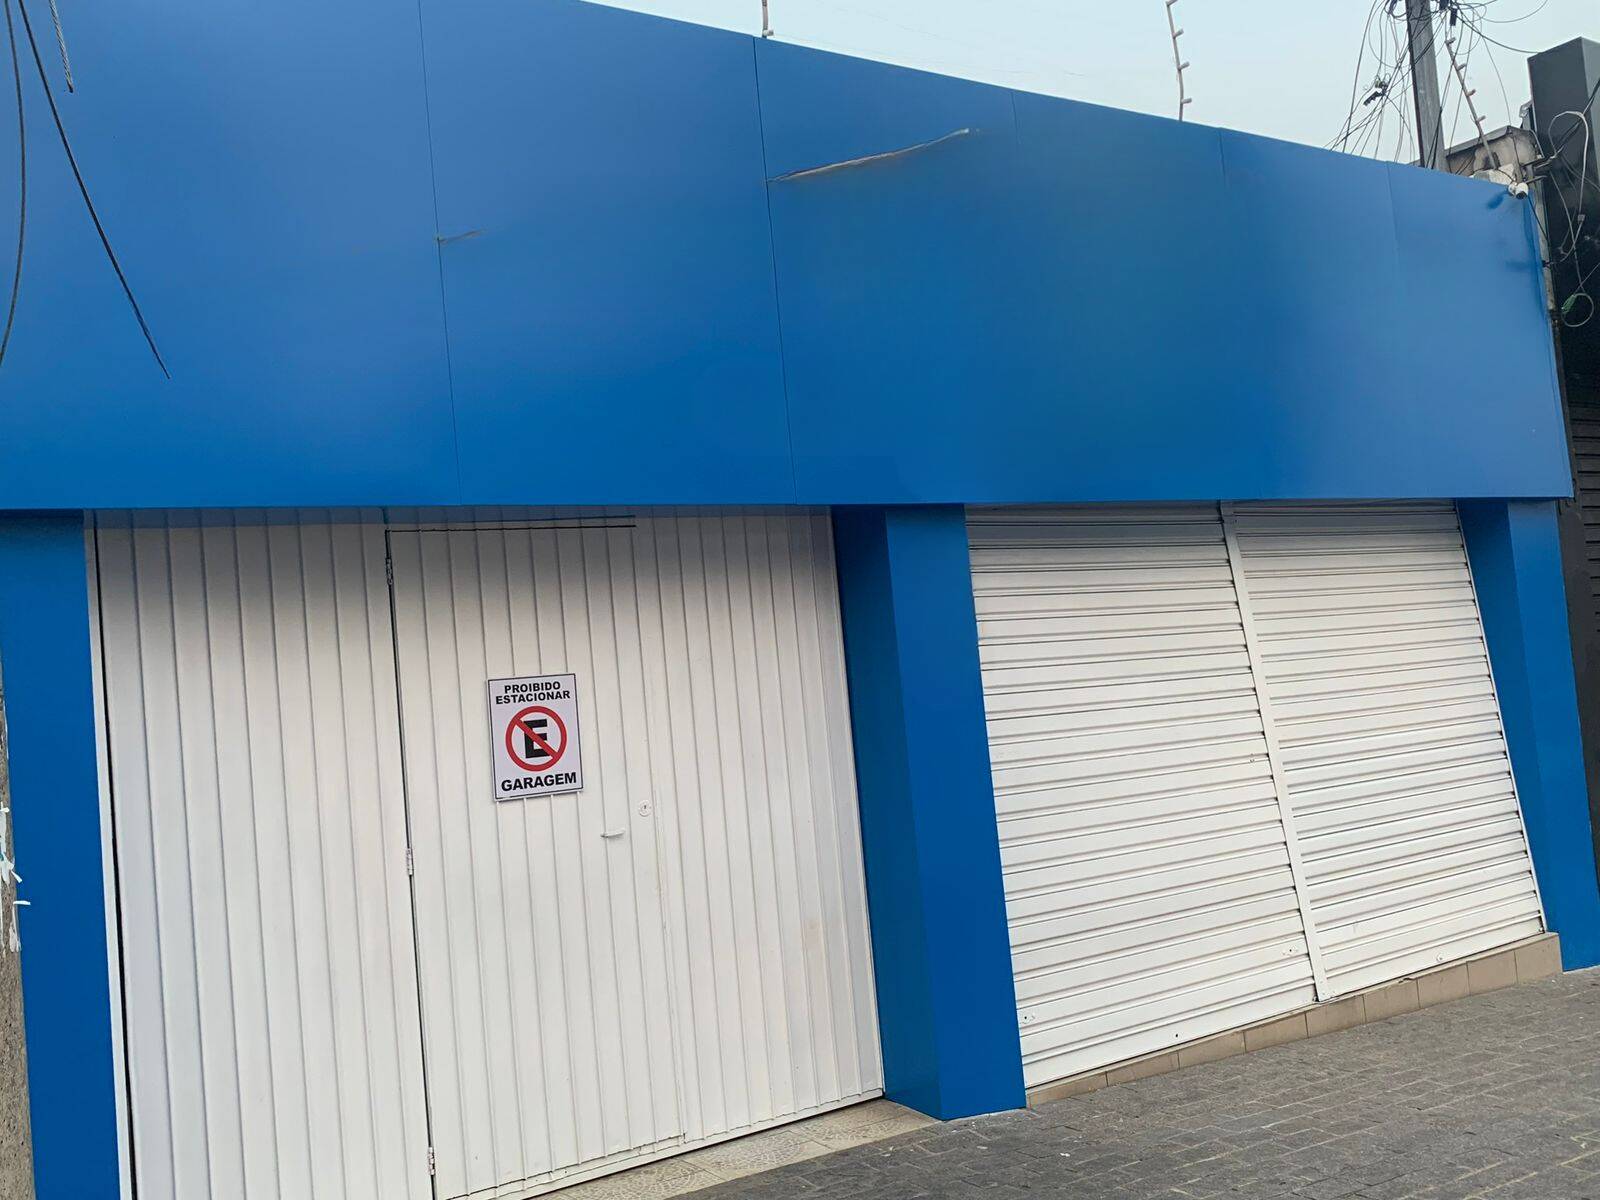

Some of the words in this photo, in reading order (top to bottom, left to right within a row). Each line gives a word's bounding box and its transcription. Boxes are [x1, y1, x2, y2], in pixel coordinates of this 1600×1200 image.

[504, 681, 561, 694] PROIBIDO
[495, 690, 571, 705] ESTACIONAR
[524, 718, 550, 759] E
[501, 772, 577, 792] GARAGEM
